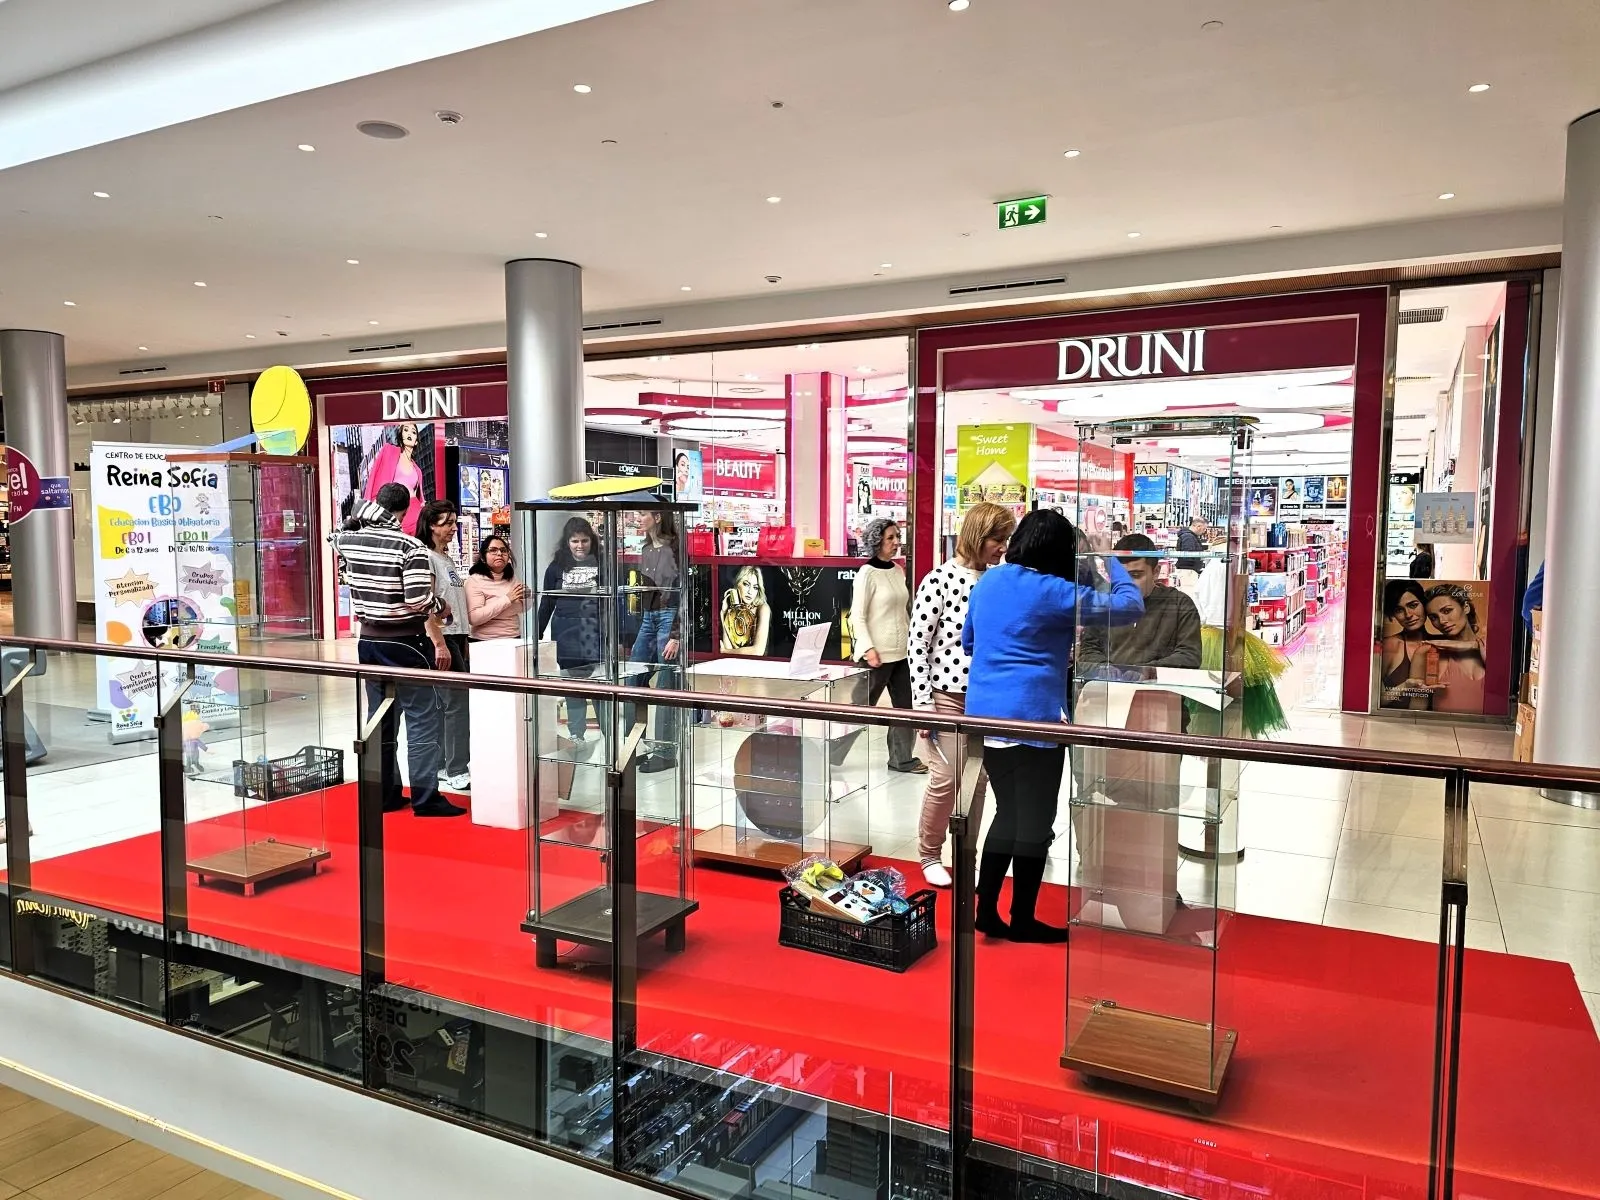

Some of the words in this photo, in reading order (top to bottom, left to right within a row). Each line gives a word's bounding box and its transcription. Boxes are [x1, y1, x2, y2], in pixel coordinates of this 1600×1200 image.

[1057, 329, 1206, 381] DRUNI
[382, 386, 461, 420] DRUNI
[975, 434, 1008, 444] Sweet
[976, 445, 1007, 455] Home
[105, 451, 134, 459] CENTRO
[135, 452, 144, 460] DE
[716, 458, 762, 480] BEAUTY
[106, 464, 162, 488] Reina
[166, 464, 218, 489] Sofía
[13, 505, 23, 513] FM
[148, 494, 182, 516] EBO
[177, 518, 221, 528] Obligatoria
[121, 531, 145, 546] EBO
[147, 531, 151, 544] I
[177, 530, 199, 545] EBO
[201, 530, 209, 541] II
[115, 546, 124, 554] De
[189, 545, 205, 553] 16/18
[838, 569, 856, 580] rab
[783, 610, 821, 620] MILLION
